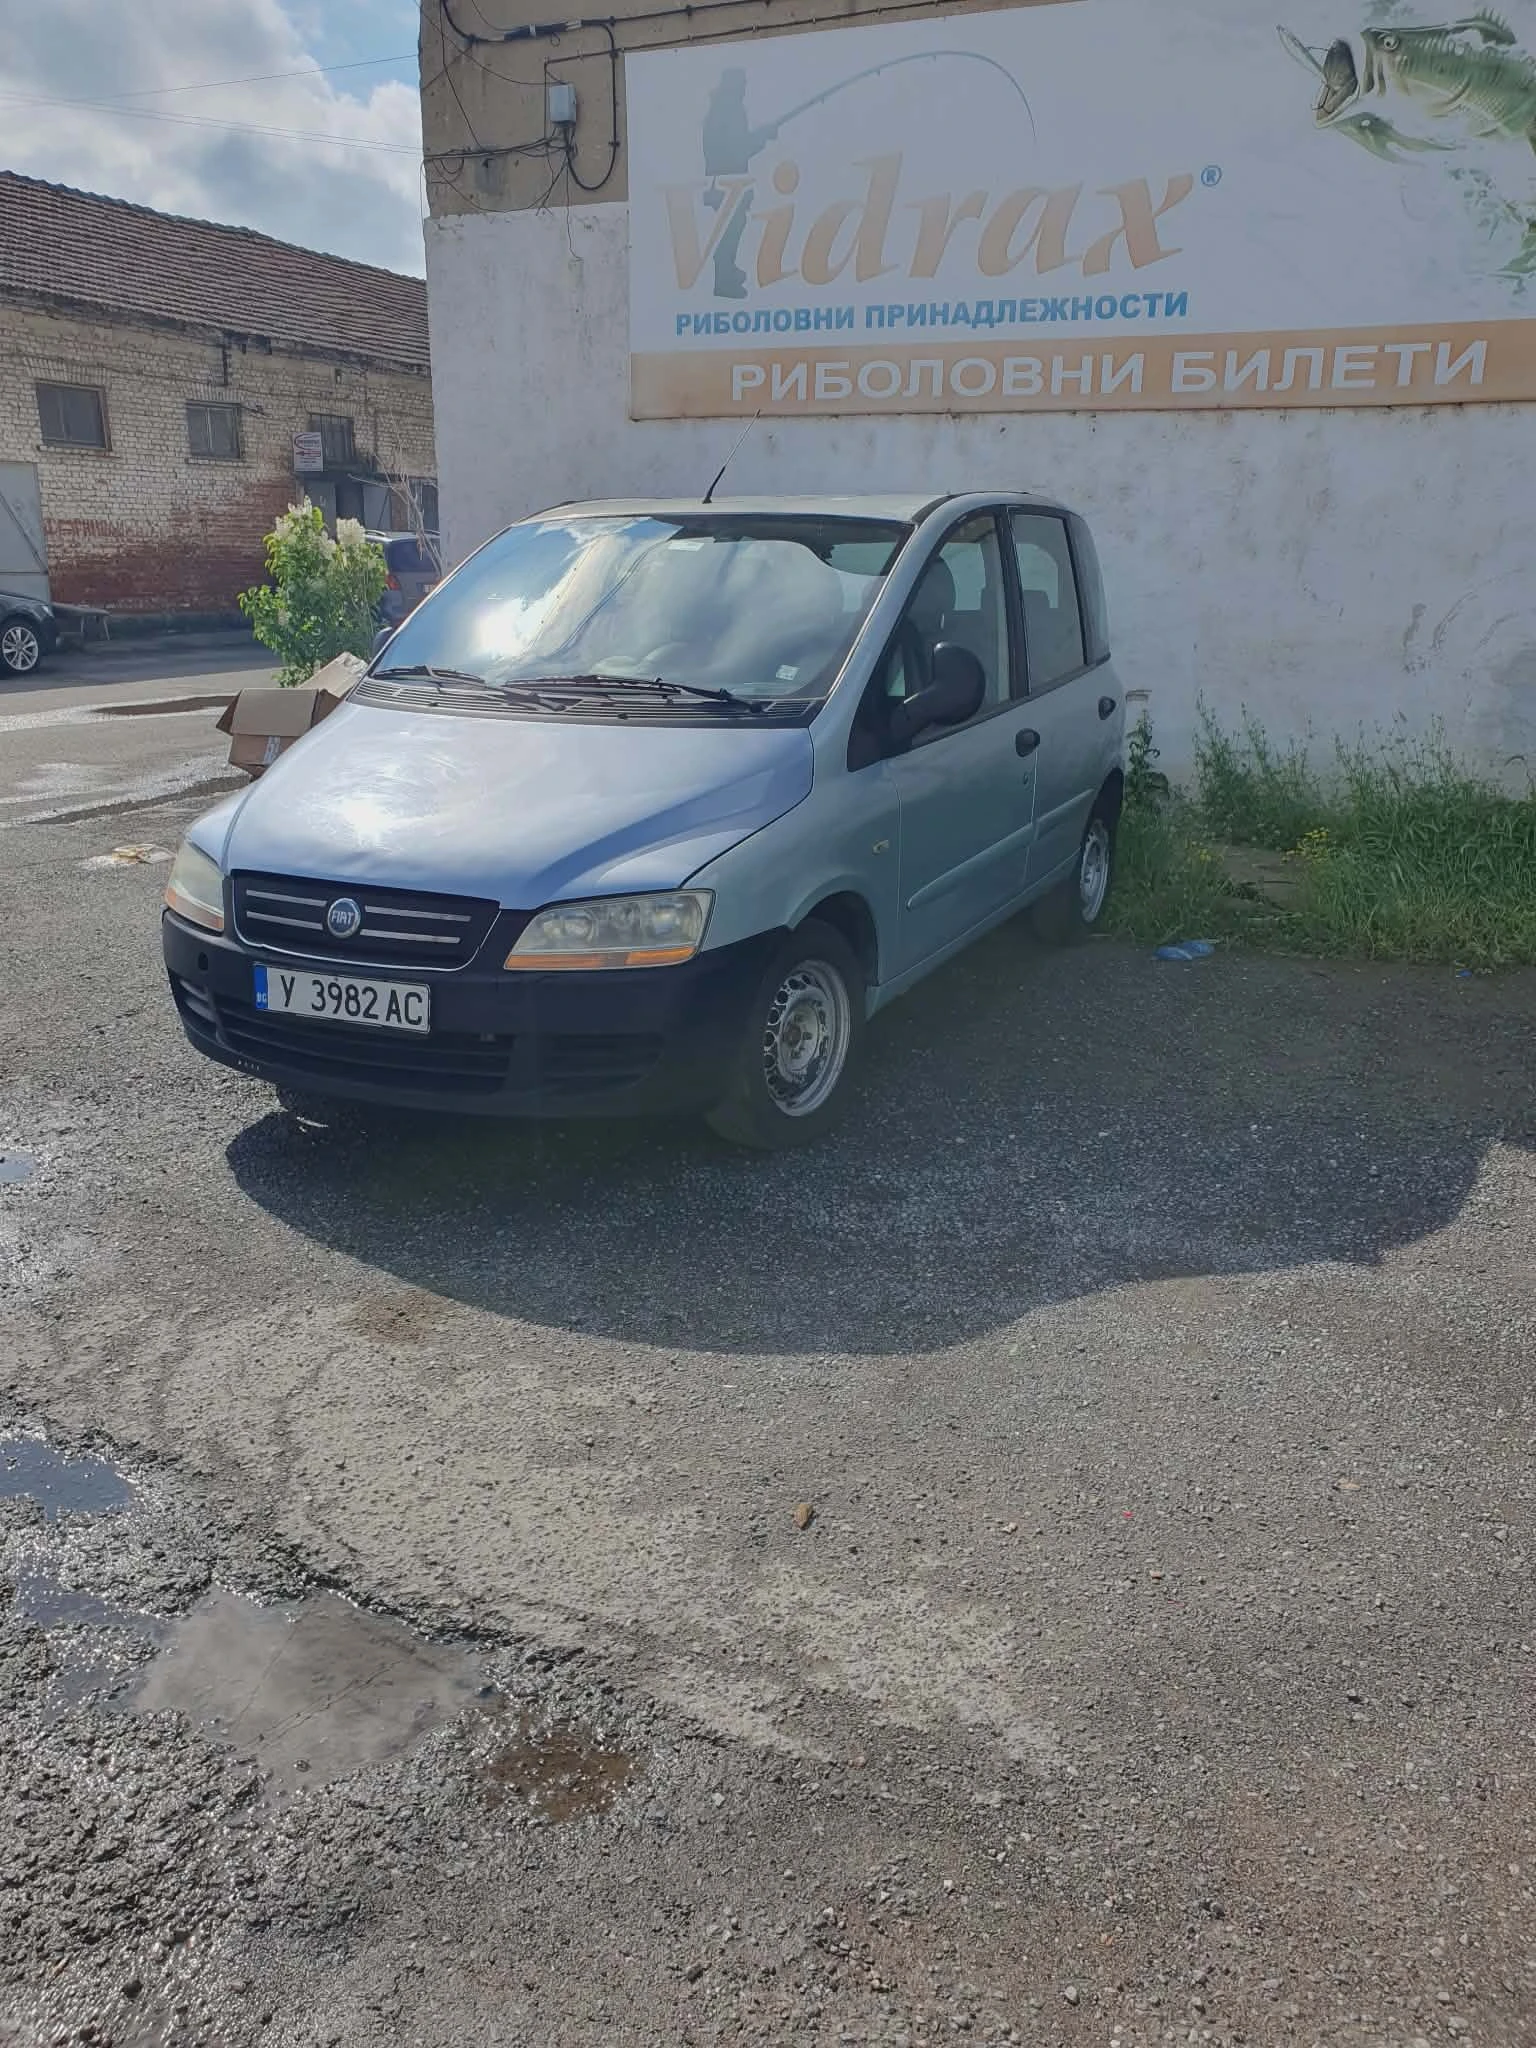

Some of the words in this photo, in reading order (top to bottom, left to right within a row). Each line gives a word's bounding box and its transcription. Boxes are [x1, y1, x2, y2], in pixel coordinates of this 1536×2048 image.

[657, 150, 1194, 290] Vidrax
[675, 305, 855, 336] РИБОЛОВНИ
[864, 291, 1188, 329] ПРИНАДЛЕЖНОСТИ
[731, 353, 1145, 402] РИБОЛОВНИ
[1171, 340, 1488, 393] БИЛЕТИ
[331, 910, 355, 926] FIAT
[311, 979, 379, 1020] 3982
[385, 988, 424, 1026] AC
